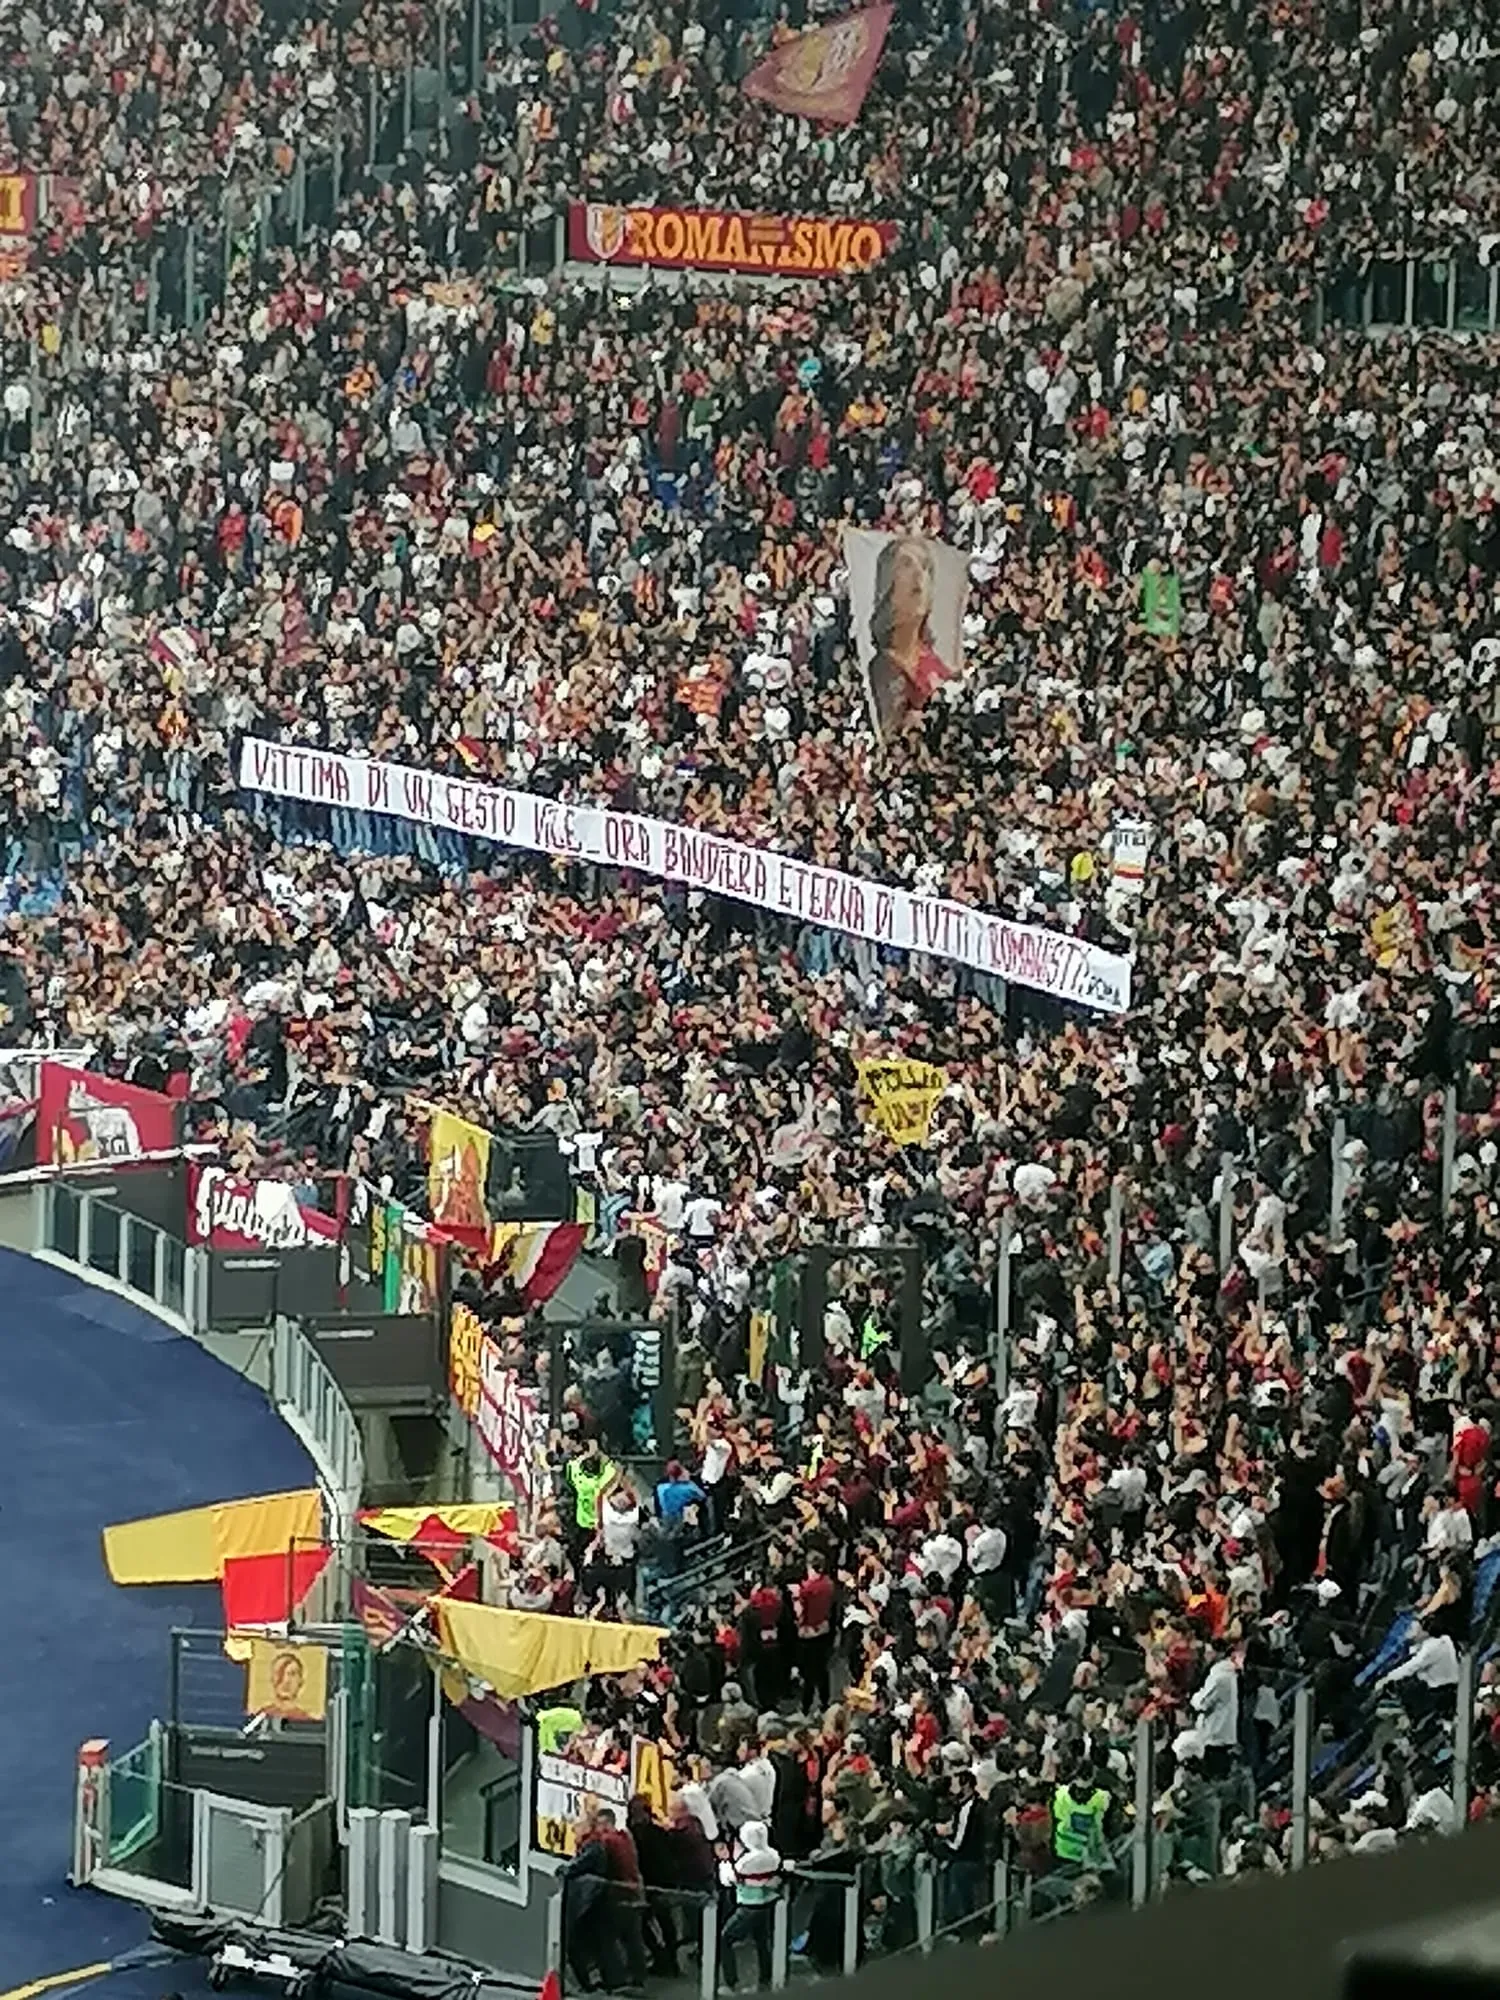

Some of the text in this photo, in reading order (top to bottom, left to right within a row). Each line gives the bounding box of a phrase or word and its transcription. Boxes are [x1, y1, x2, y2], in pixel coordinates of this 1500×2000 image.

[253, 743, 350, 802] VITTIMA
[367, 764, 389, 808] DI
[404, 772, 433, 820] UN
[446, 782, 516, 836] GESTO
[604, 816, 650, 866] ORA
[664, 828, 767, 901] BANDIERA
[779, 862, 865, 932] ETERNA
[874, 890, 895, 939] DI
[908, 899, 969, 958] TUTTI
